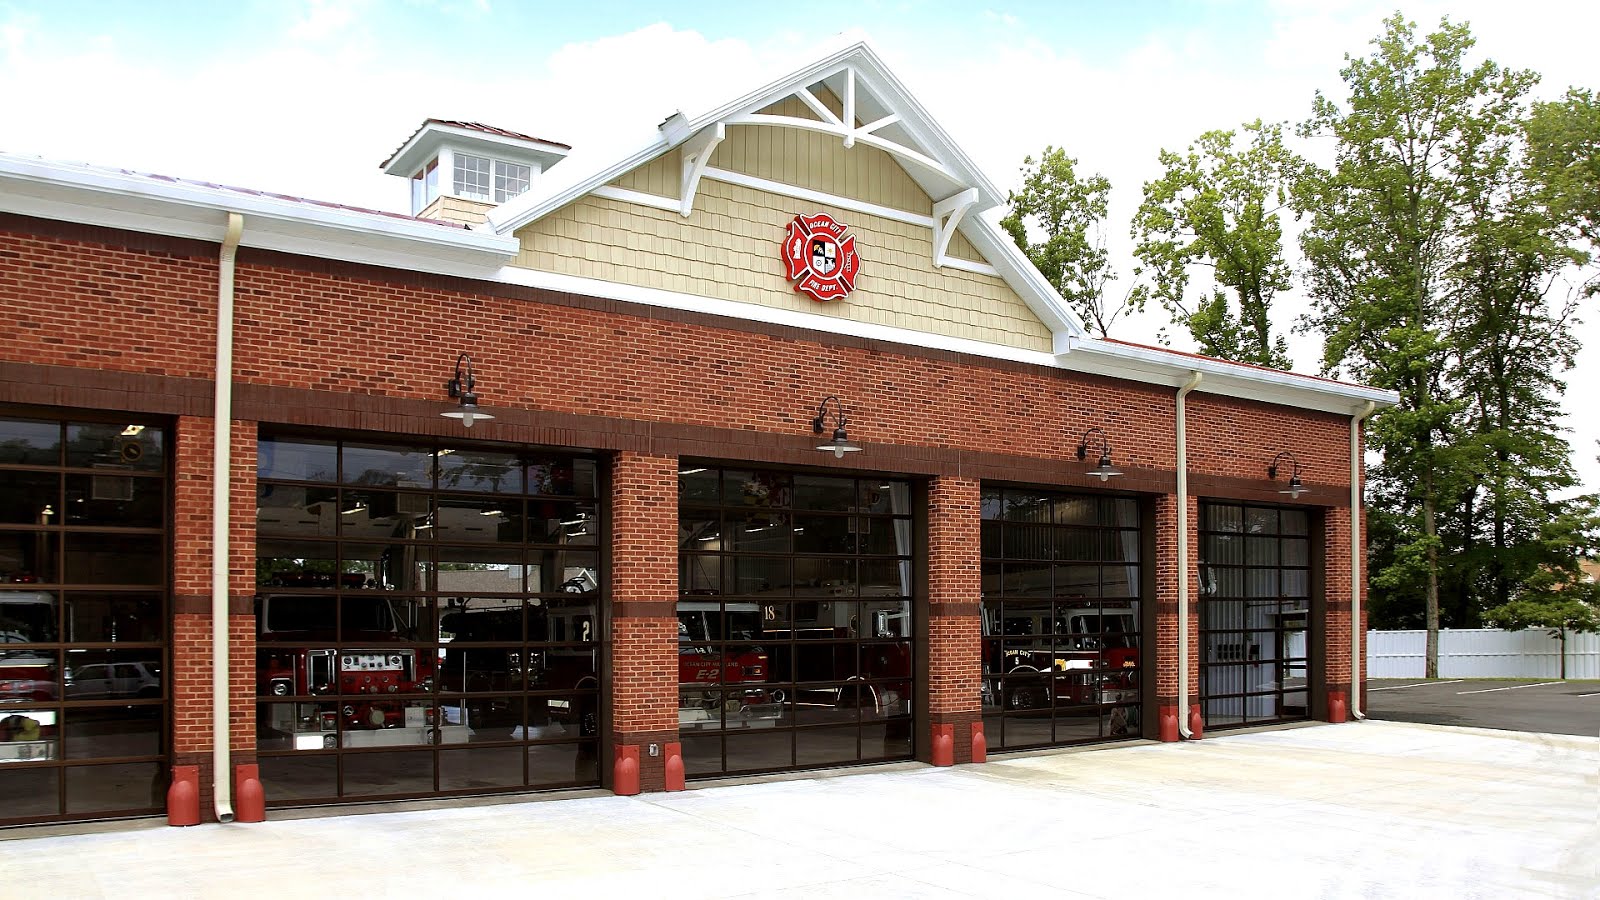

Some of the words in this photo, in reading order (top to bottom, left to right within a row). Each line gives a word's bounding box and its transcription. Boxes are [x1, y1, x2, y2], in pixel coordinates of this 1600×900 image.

[809, 221, 830, 229] OCEAN
[830, 223, 842, 235] CITY
[808, 280, 821, 290] FIRE
[764, 605, 775, 621] 18
[582, 620, 590, 642] 2
[1014, 656, 1020, 665] 5
[695, 668, 720, 680] E-2
